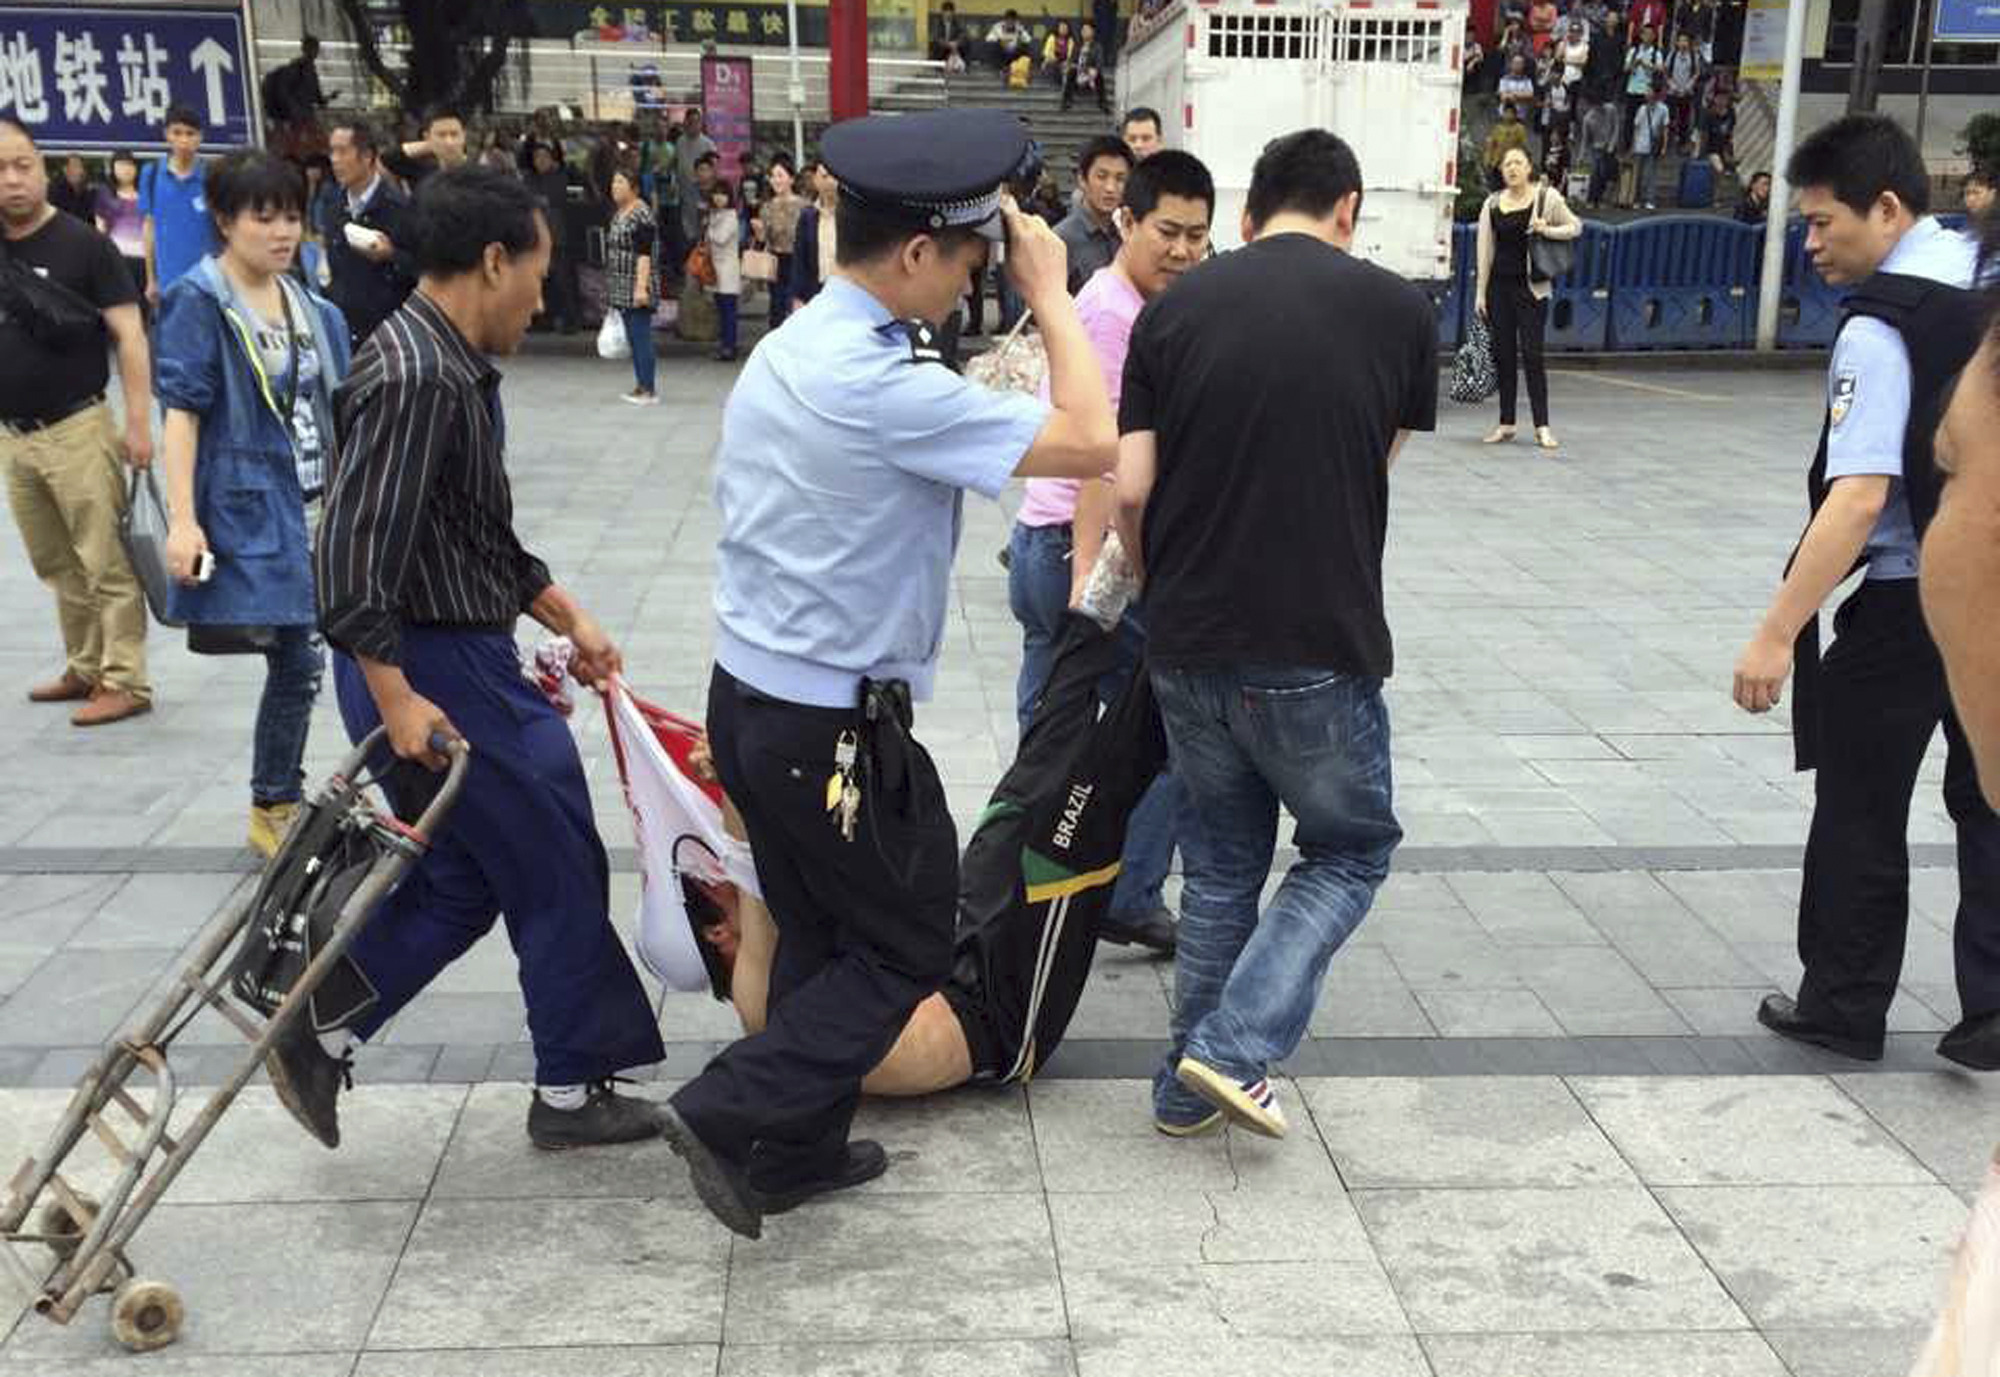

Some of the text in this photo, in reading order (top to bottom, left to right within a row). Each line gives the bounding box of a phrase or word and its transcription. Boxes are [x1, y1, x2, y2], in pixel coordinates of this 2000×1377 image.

[0, 31, 171, 126] 地铁站
[1053, 784, 1094, 850] BRAZIL
